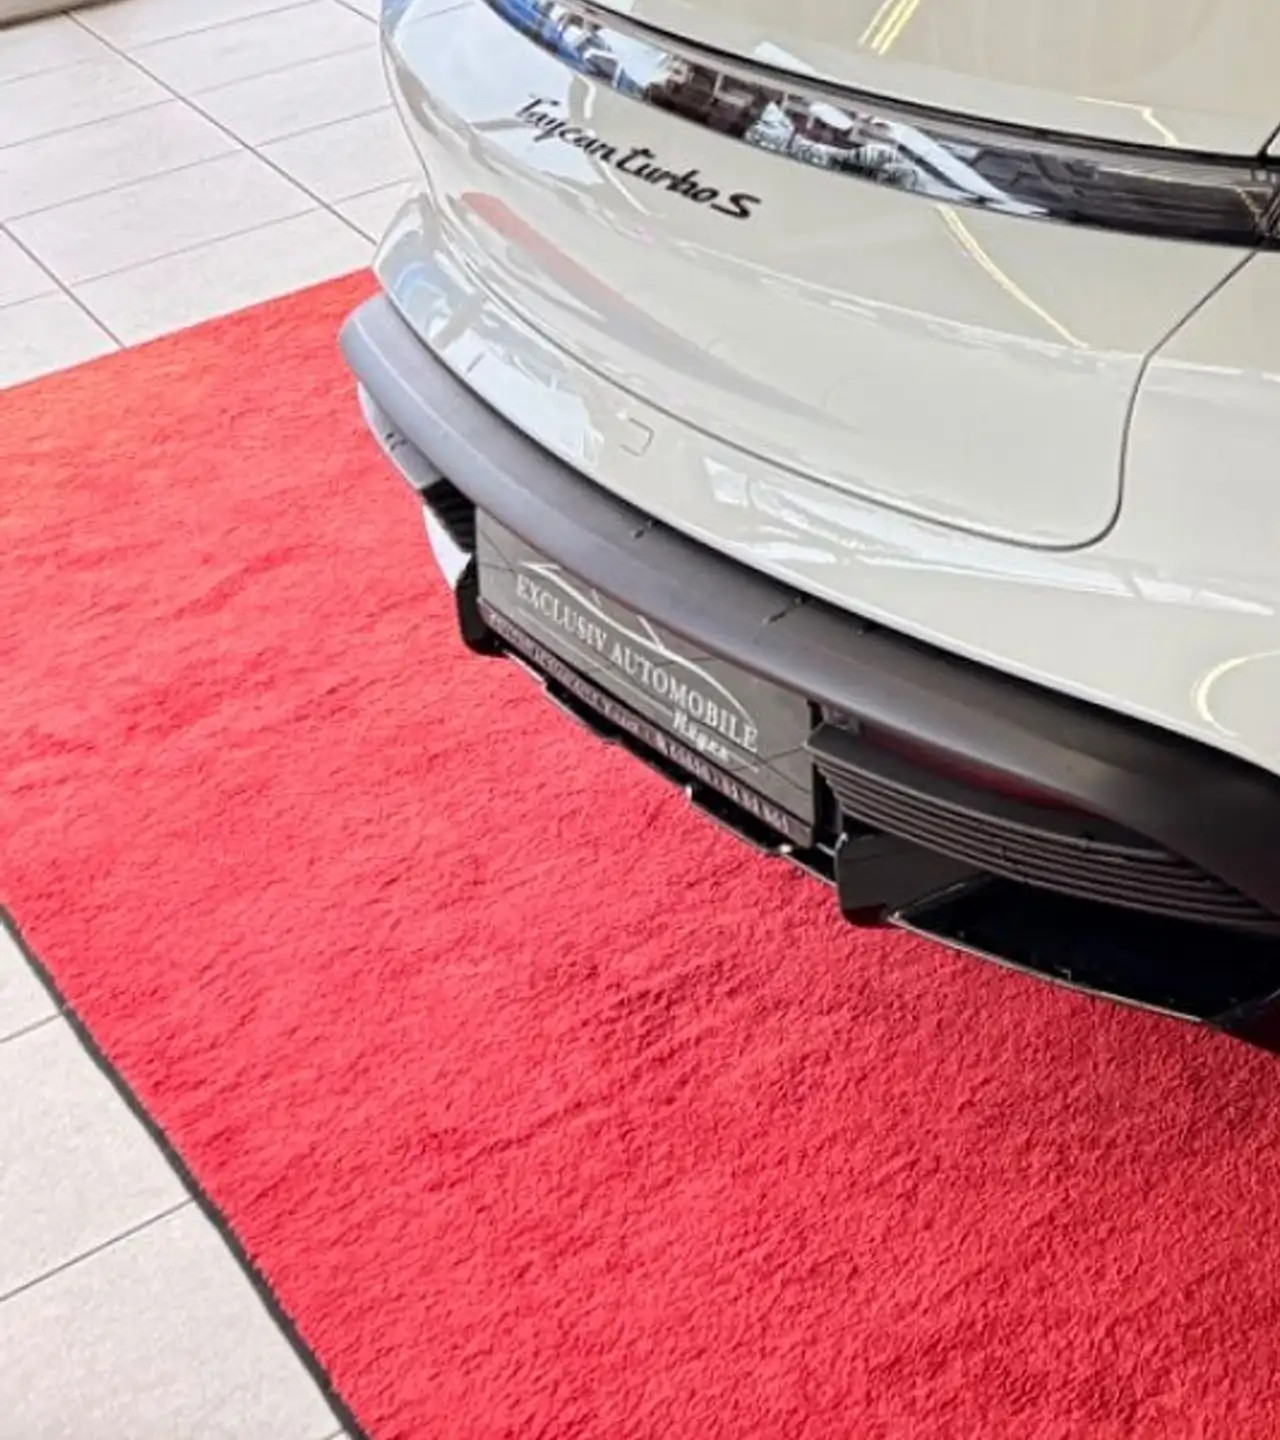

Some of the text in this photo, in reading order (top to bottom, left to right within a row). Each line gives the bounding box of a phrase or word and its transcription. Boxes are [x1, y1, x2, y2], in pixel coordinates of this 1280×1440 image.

[515, 94, 762, 220] Taycan turbo S
[516, 573, 607, 652] EXCLUSIV
[611, 643, 759, 752] AUTOMOBILE
